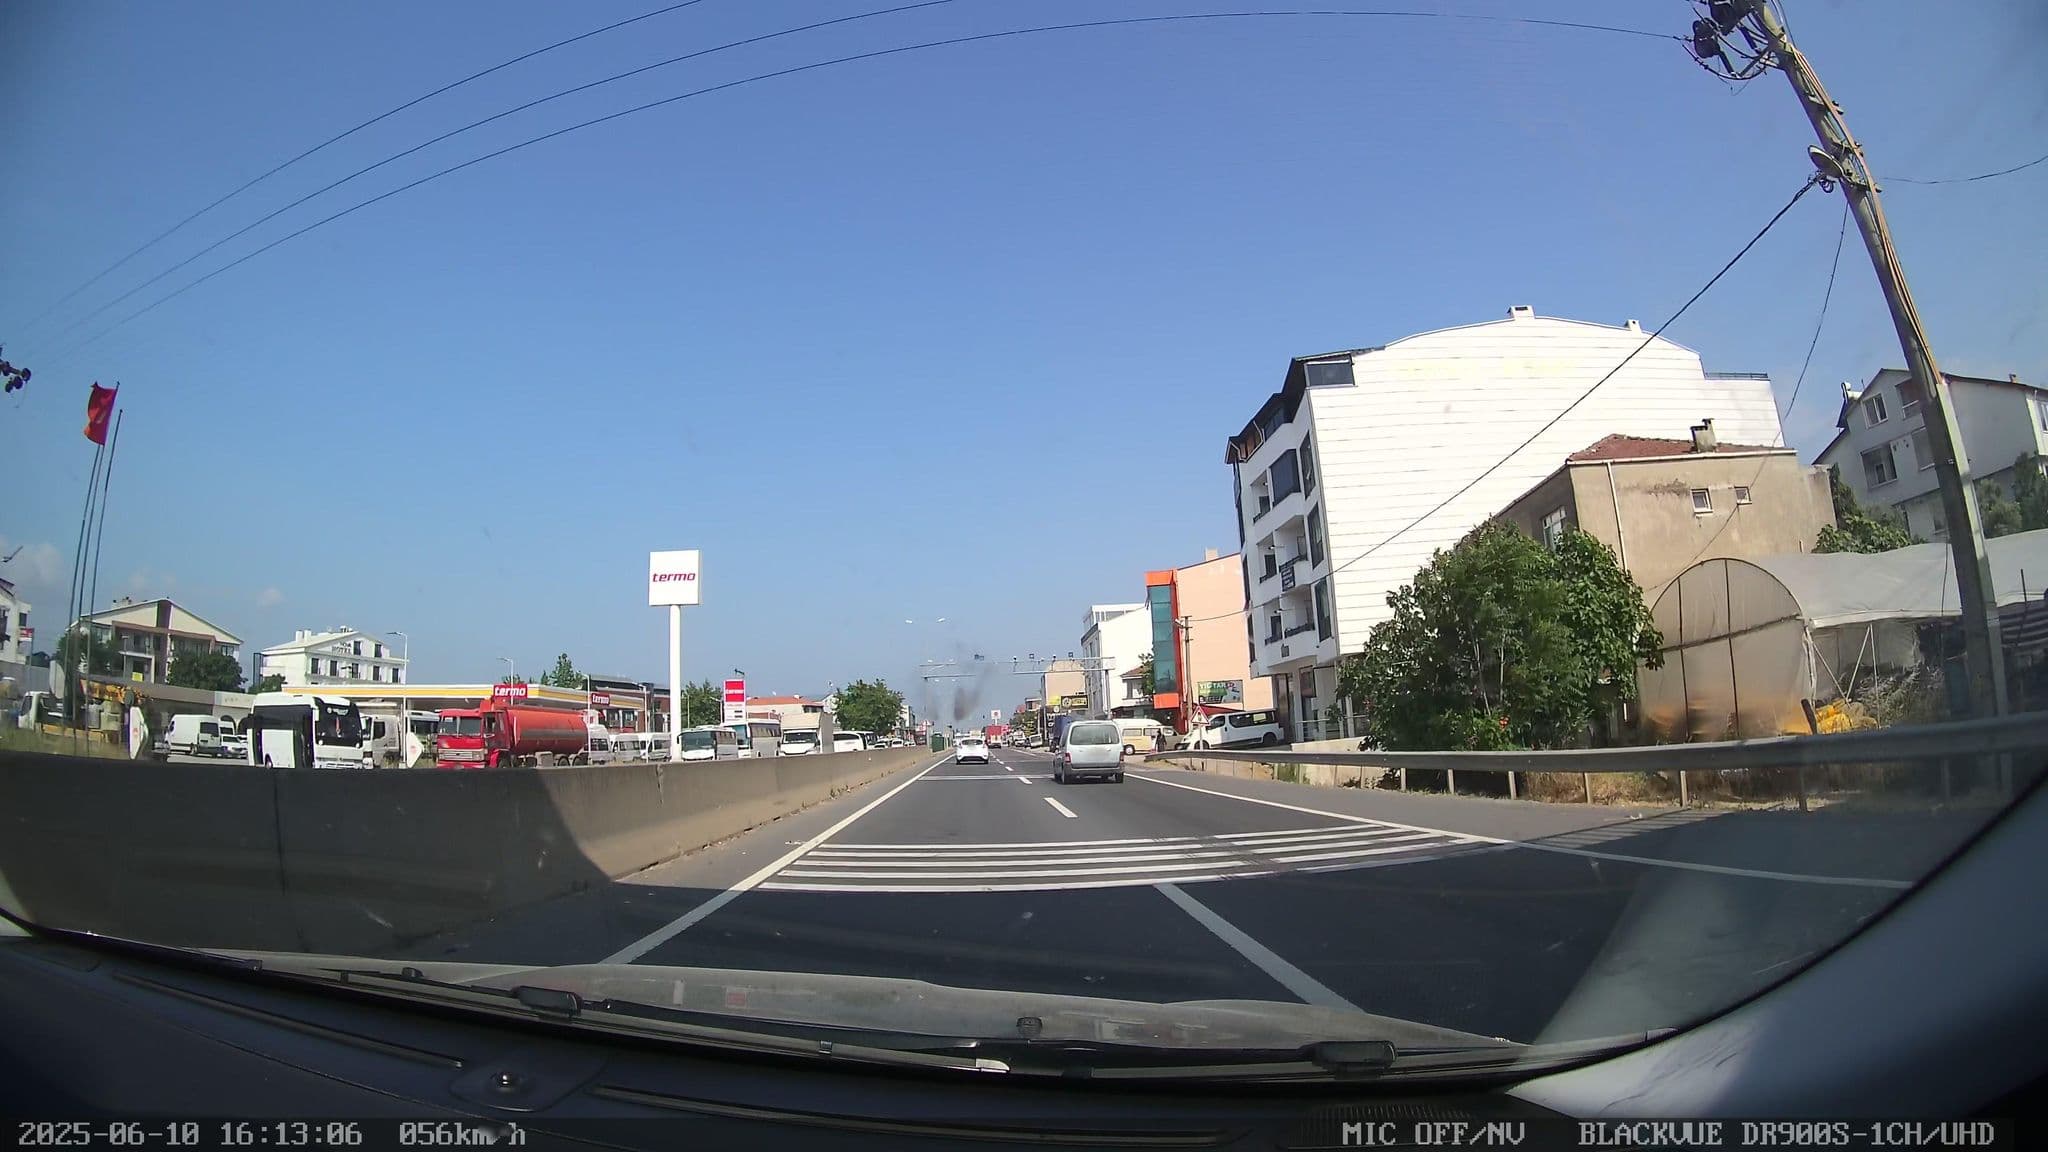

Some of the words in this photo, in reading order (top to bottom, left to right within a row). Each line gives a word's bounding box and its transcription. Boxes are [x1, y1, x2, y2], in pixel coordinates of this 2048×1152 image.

[652, 573, 696, 582] termo
[494, 686, 526, 697] termo
[592, 694, 610, 704] termo
